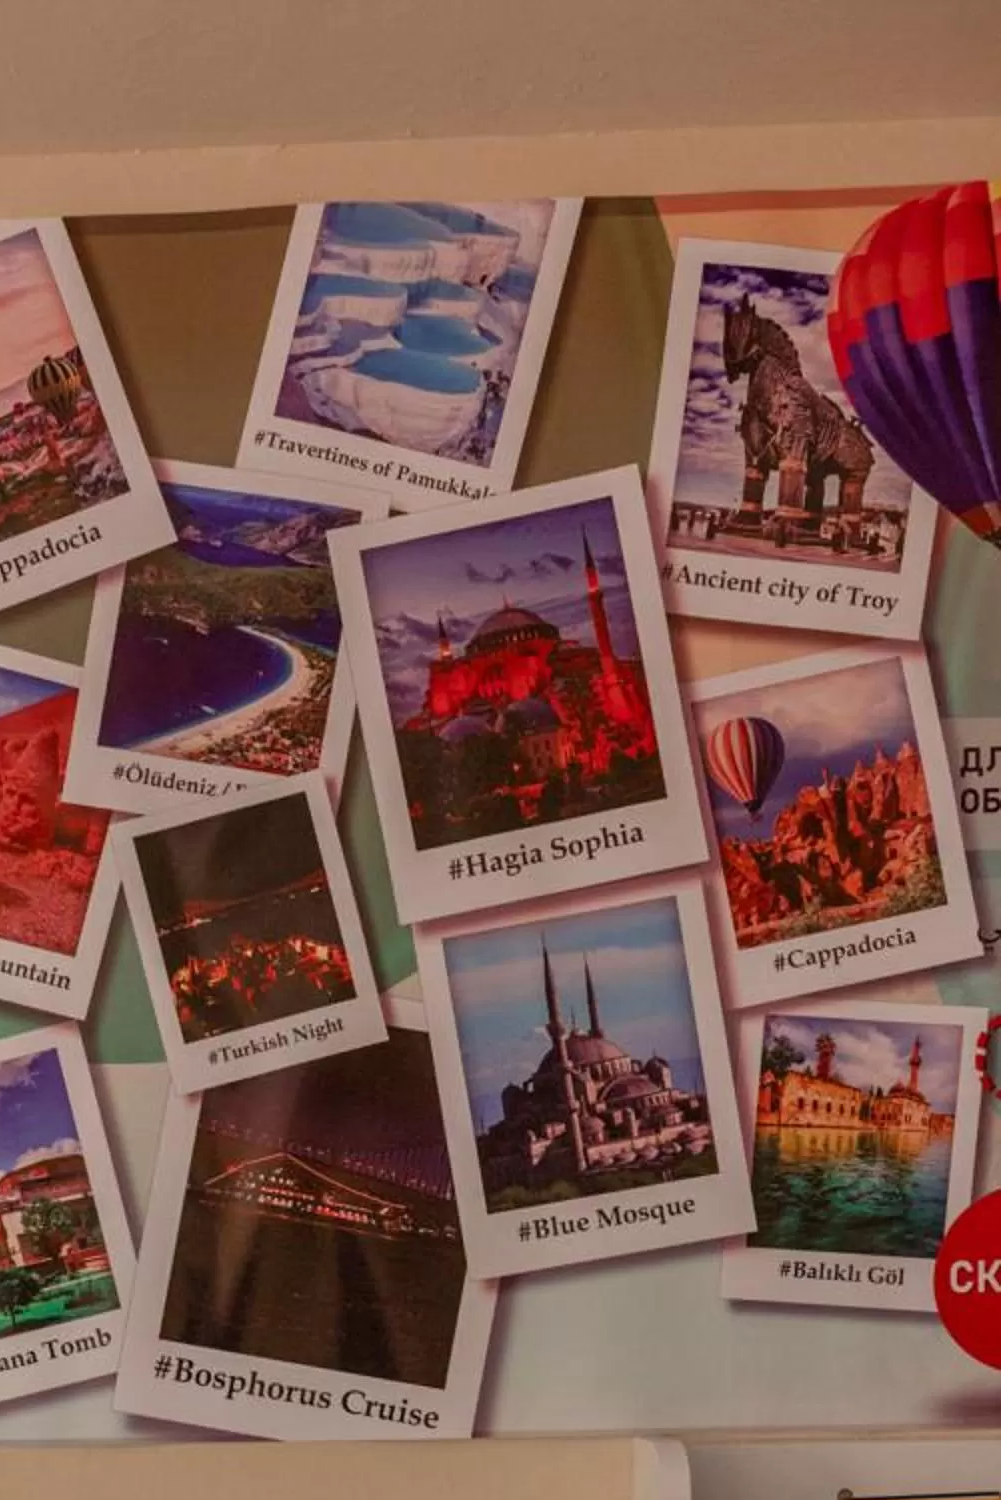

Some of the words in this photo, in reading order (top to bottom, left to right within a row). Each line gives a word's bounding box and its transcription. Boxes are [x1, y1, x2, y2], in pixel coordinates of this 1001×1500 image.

[254, 430, 369, 472] #Travertines
[373, 461, 394, 478] of
[396, 463, 498, 500] Pamukkal
[662, 563, 762, 595] #Ancient
[768, 577, 809, 605] city
[816, 583, 841, 603] of
[846, 585, 899, 617] Troy
[112, 762, 217, 797] #Ölüdeniz
[448, 843, 543, 880] #Hagia
[550, 823, 645, 860] Sophia
[773, 928, 917, 972] #Cappadocia
[208, 1031, 289, 1065] #Turkish
[292, 1017, 344, 1043] Night
[518, 1216, 591, 1242] #Blue
[596, 1199, 696, 1229] Mosque
[867, 1266, 905, 1287] Göl
[41, 1327, 112, 1361] Tomb
[153, 1355, 332, 1409] #Bosphorus
[341, 1388, 440, 1430] Cruise
